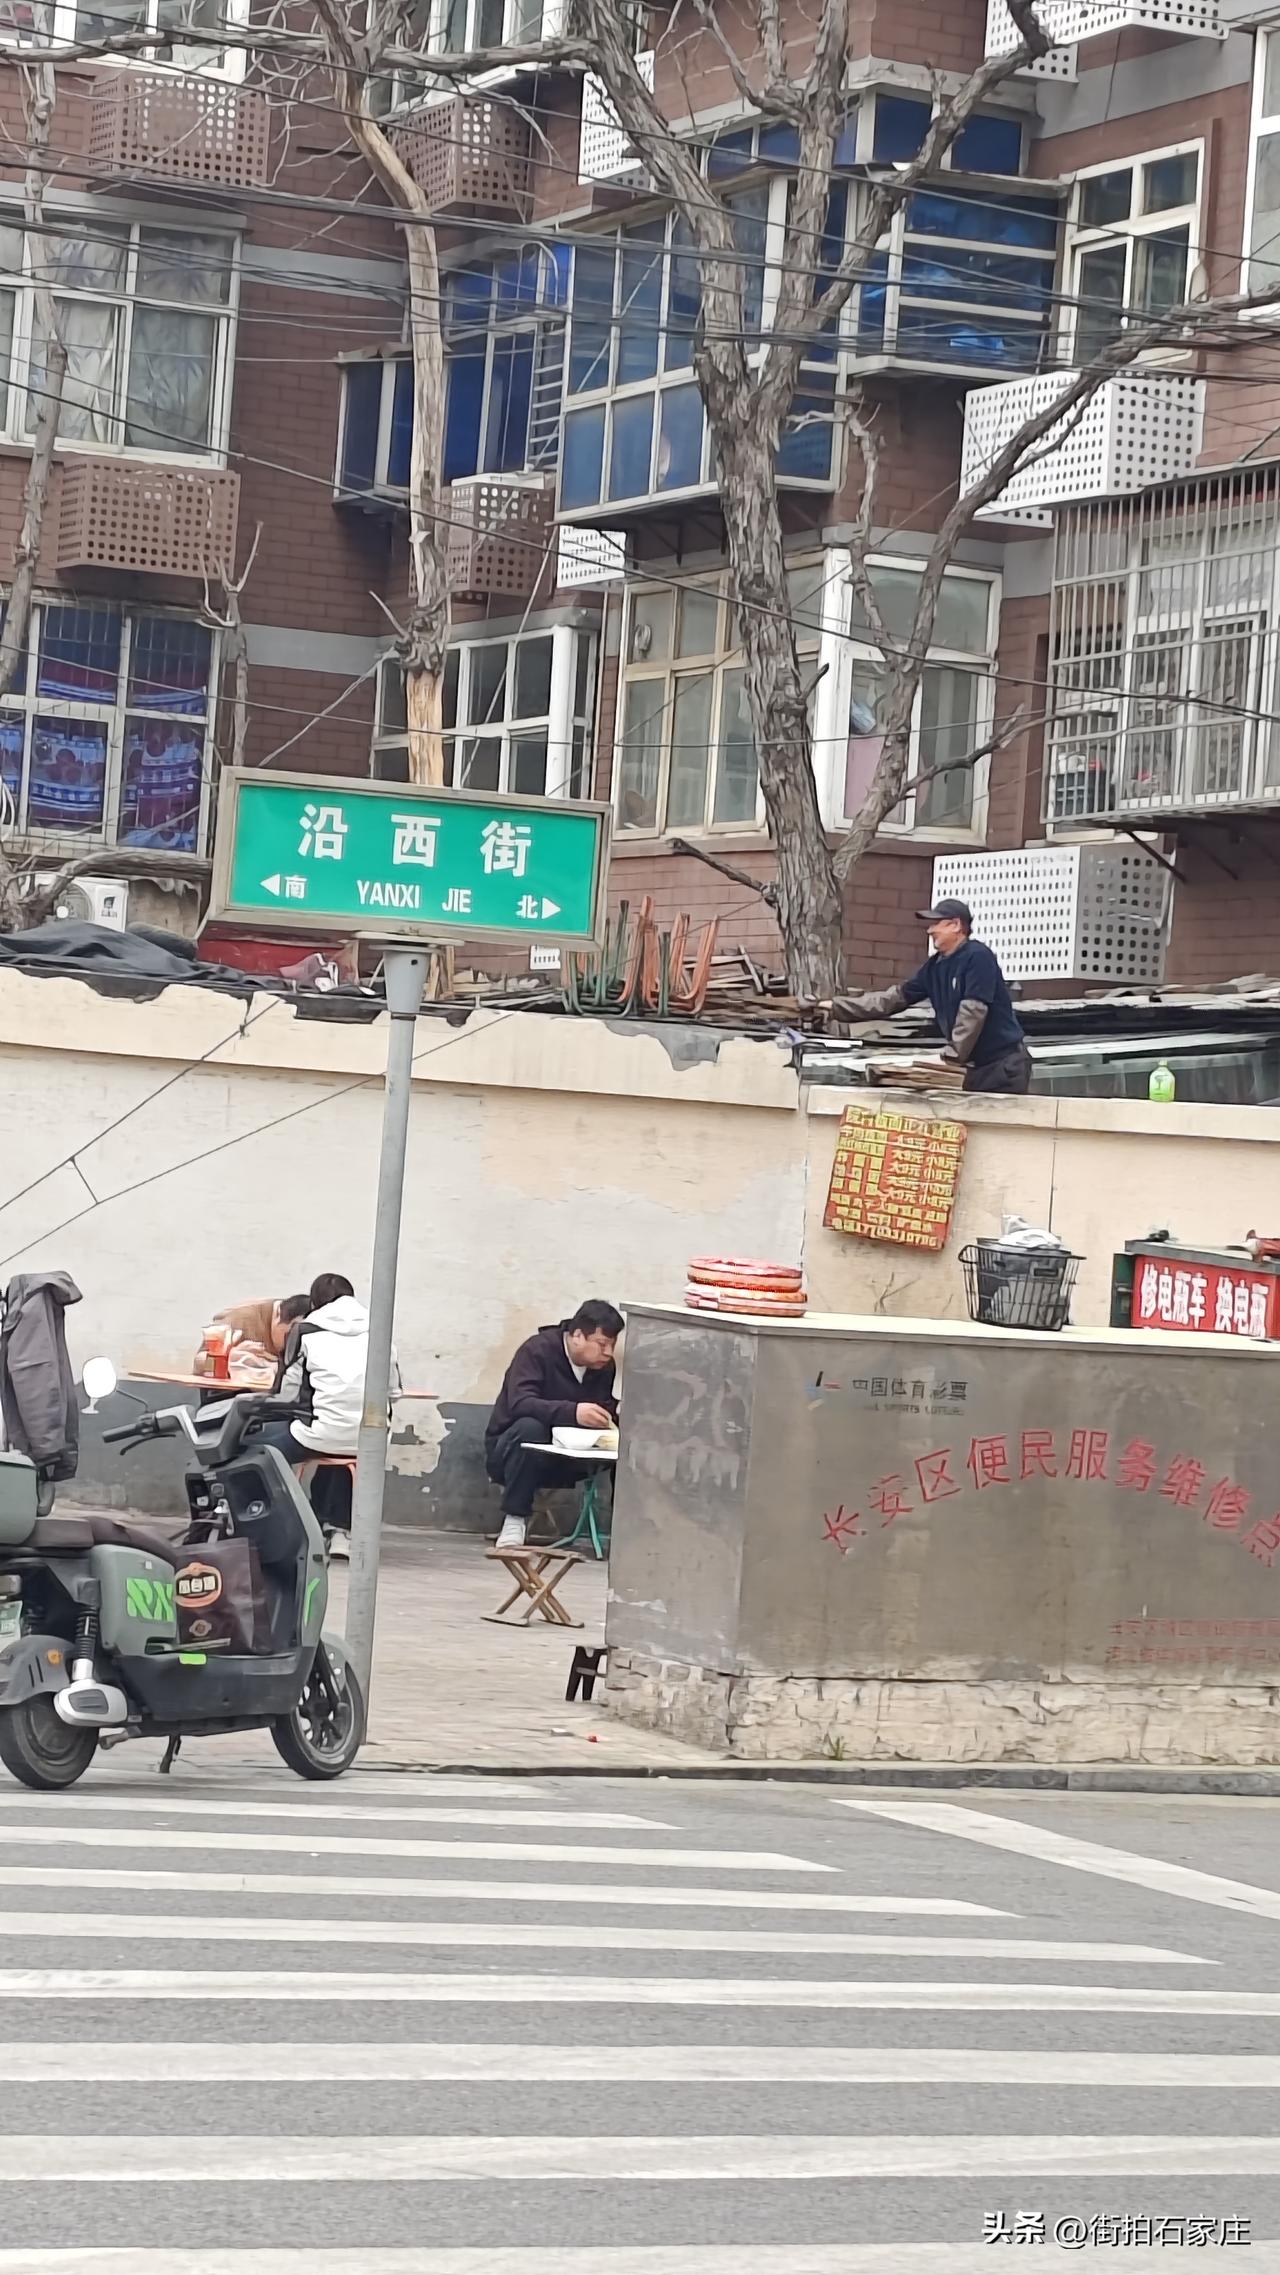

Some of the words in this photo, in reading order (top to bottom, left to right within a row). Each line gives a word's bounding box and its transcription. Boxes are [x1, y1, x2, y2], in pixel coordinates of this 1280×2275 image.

[297, 803, 532, 878] 沿西街
[284, 874, 308, 899] 南
[356, 879, 420, 910] YANXI
[440, 887, 472, 914] JIE
[515, 894, 538, 919] 北
